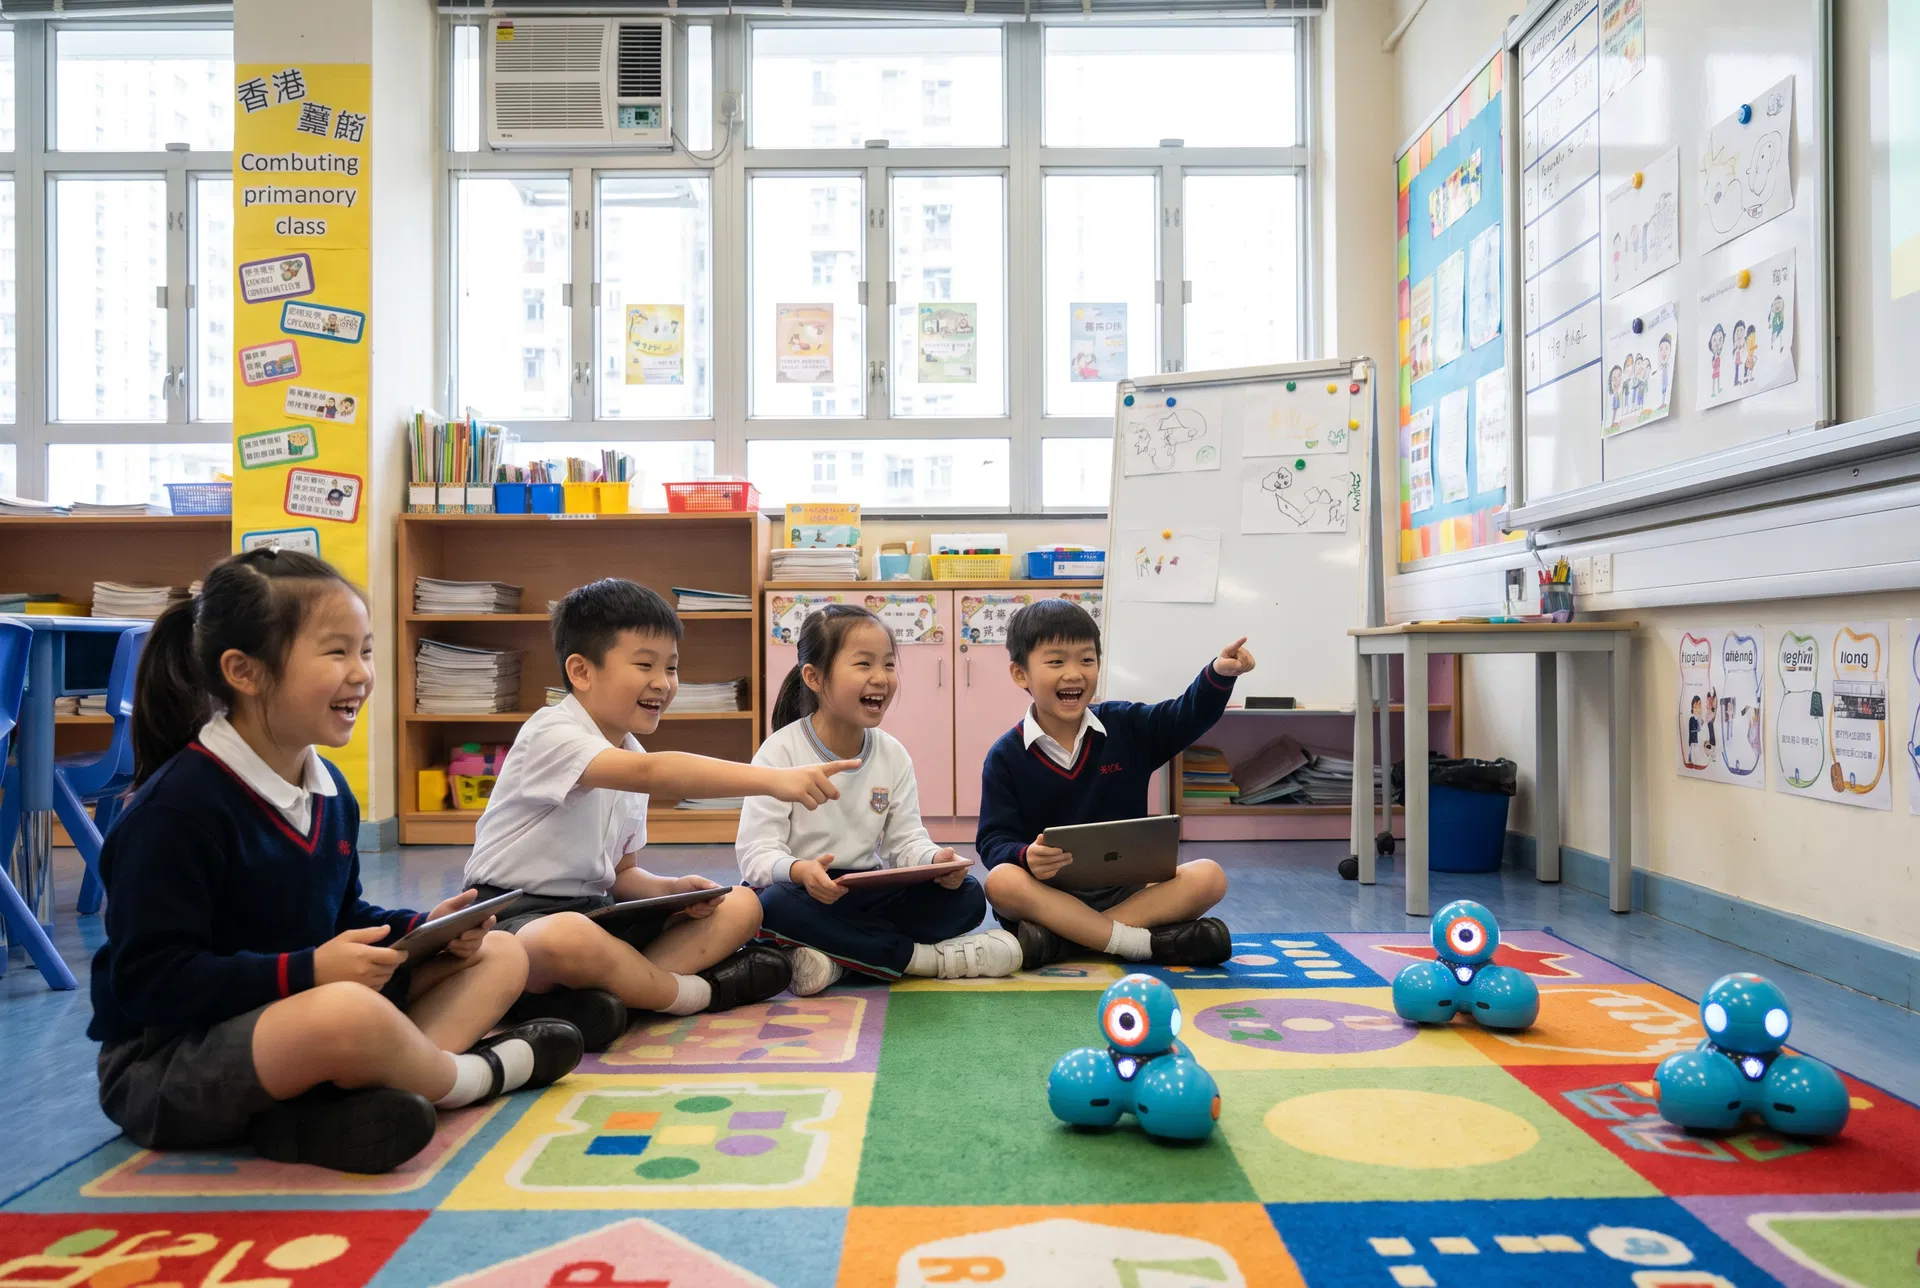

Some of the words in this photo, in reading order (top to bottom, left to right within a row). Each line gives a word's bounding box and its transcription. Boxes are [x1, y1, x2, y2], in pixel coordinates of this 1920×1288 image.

[238, 69, 305, 113] 香港
[241, 153, 358, 176] Combuting
[244, 185, 356, 208] primanory
[276, 216, 326, 235] class
